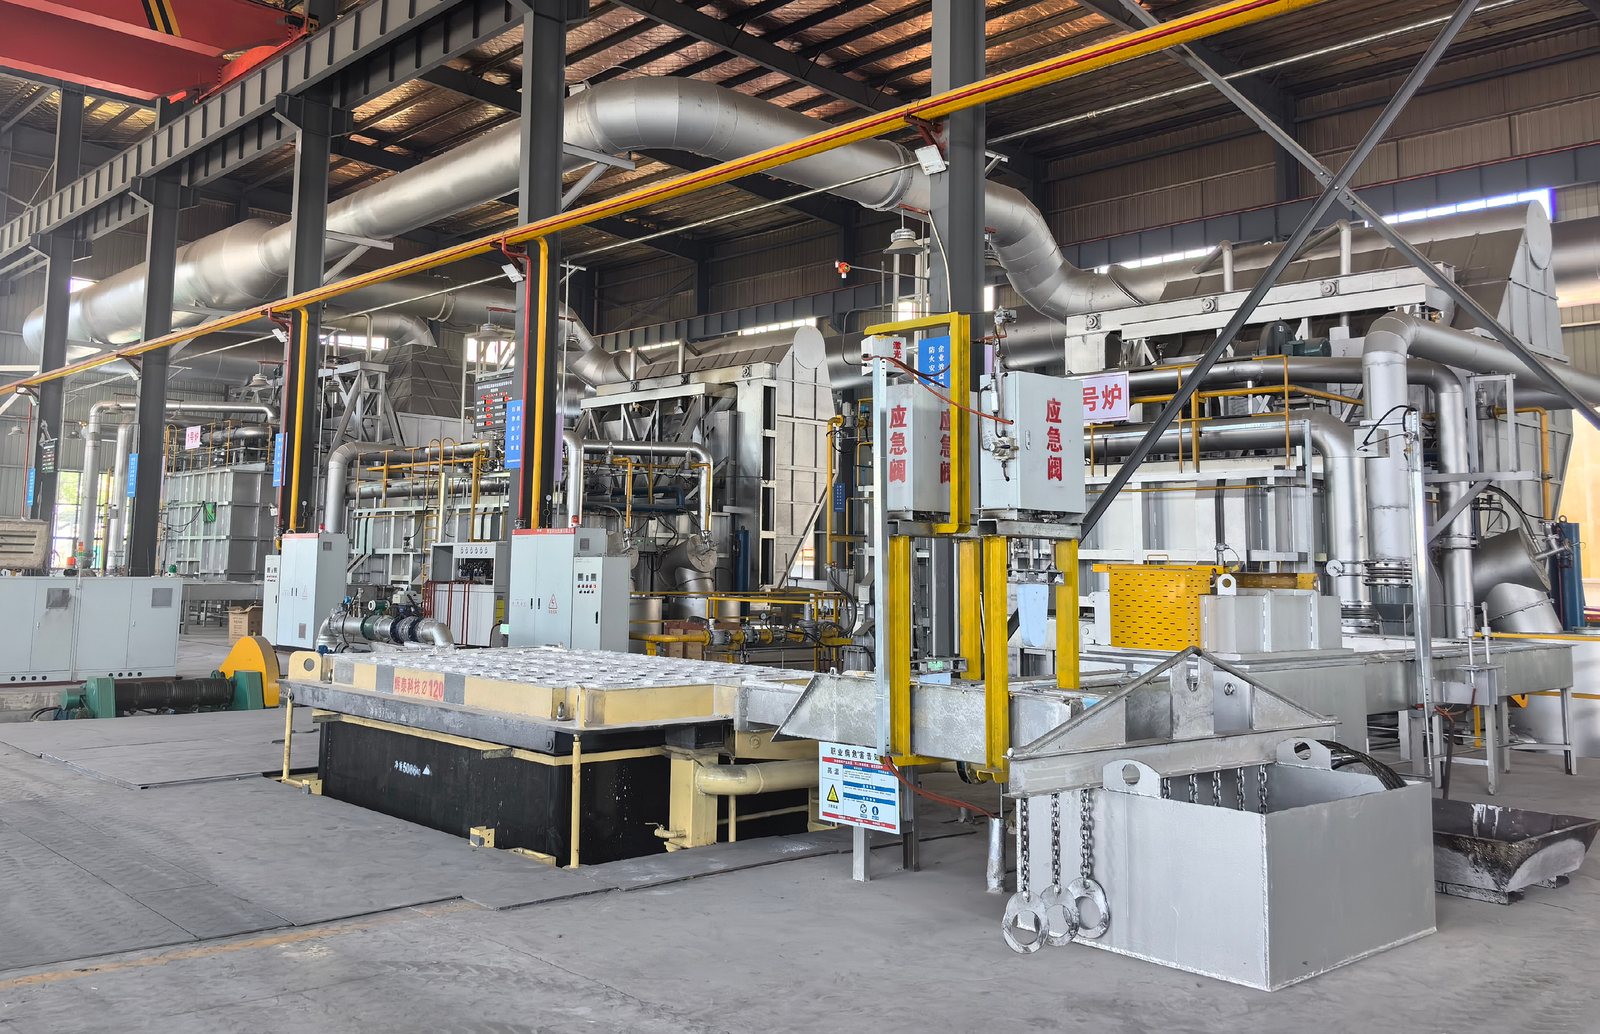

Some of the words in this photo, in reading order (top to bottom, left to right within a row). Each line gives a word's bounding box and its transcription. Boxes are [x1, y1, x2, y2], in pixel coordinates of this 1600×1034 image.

[893, 341, 902, 368] 激光
[889, 404, 907, 483] 应急阀
[1045, 397, 1063, 481] 应急阀
